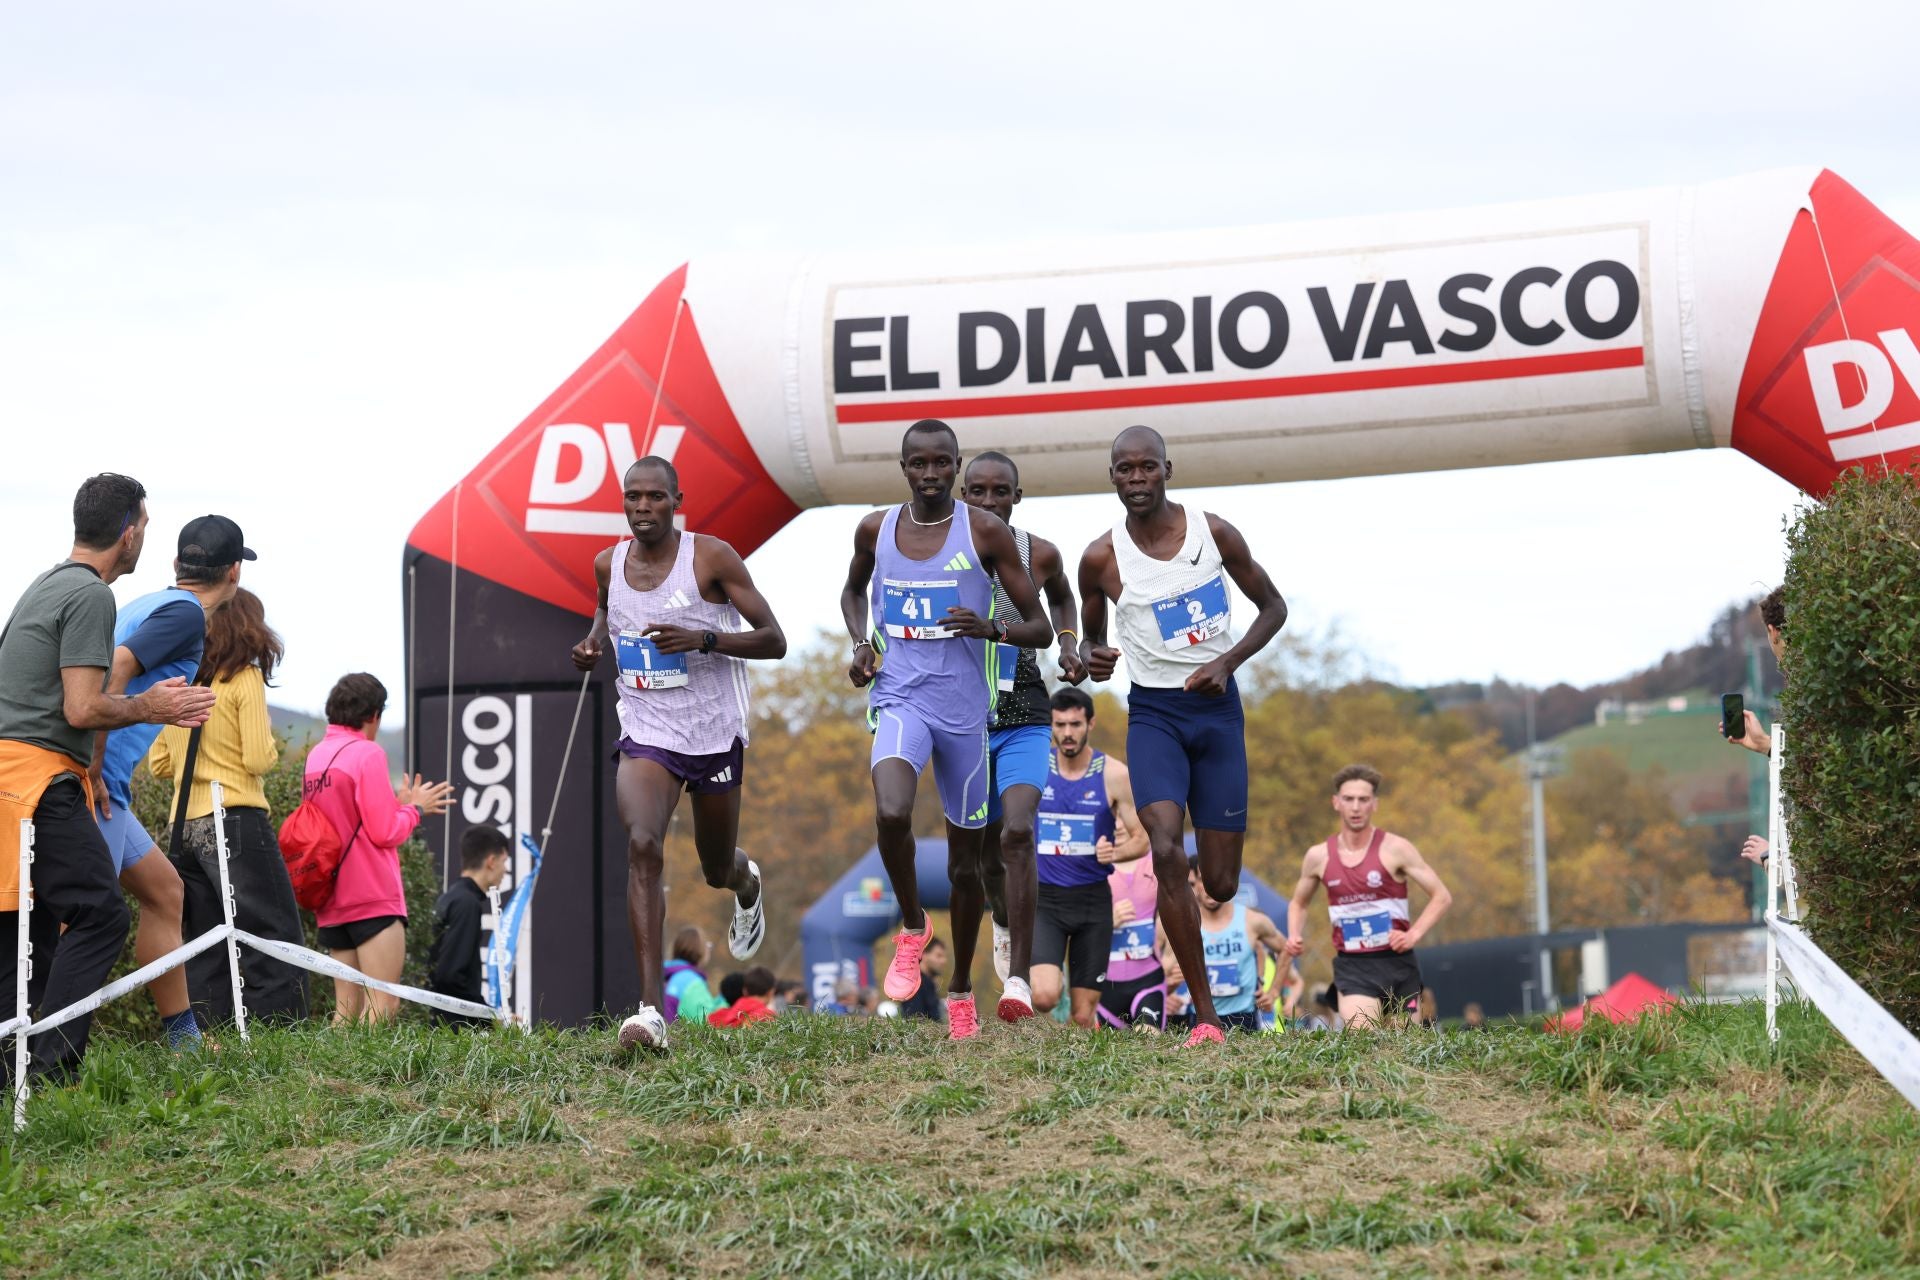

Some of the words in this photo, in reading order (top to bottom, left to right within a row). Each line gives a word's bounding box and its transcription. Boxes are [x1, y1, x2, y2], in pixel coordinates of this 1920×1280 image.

[834, 316, 940, 394] EL
[959, 291, 1290, 388] DIARIO
[1307, 260, 1640, 362] VASCO
[901, 597, 932, 620] 41
[1186, 600, 1207, 624] 2
[640, 648, 652, 670] 1
[644, 668, 681, 677] KIPROTICH
[462, 696, 513, 893] SCO
[1060, 825, 1072, 842] 3
[1361, 920, 1373, 937] 5
[1127, 931, 1140, 947] 4
[1206, 938, 1242, 957] erja
